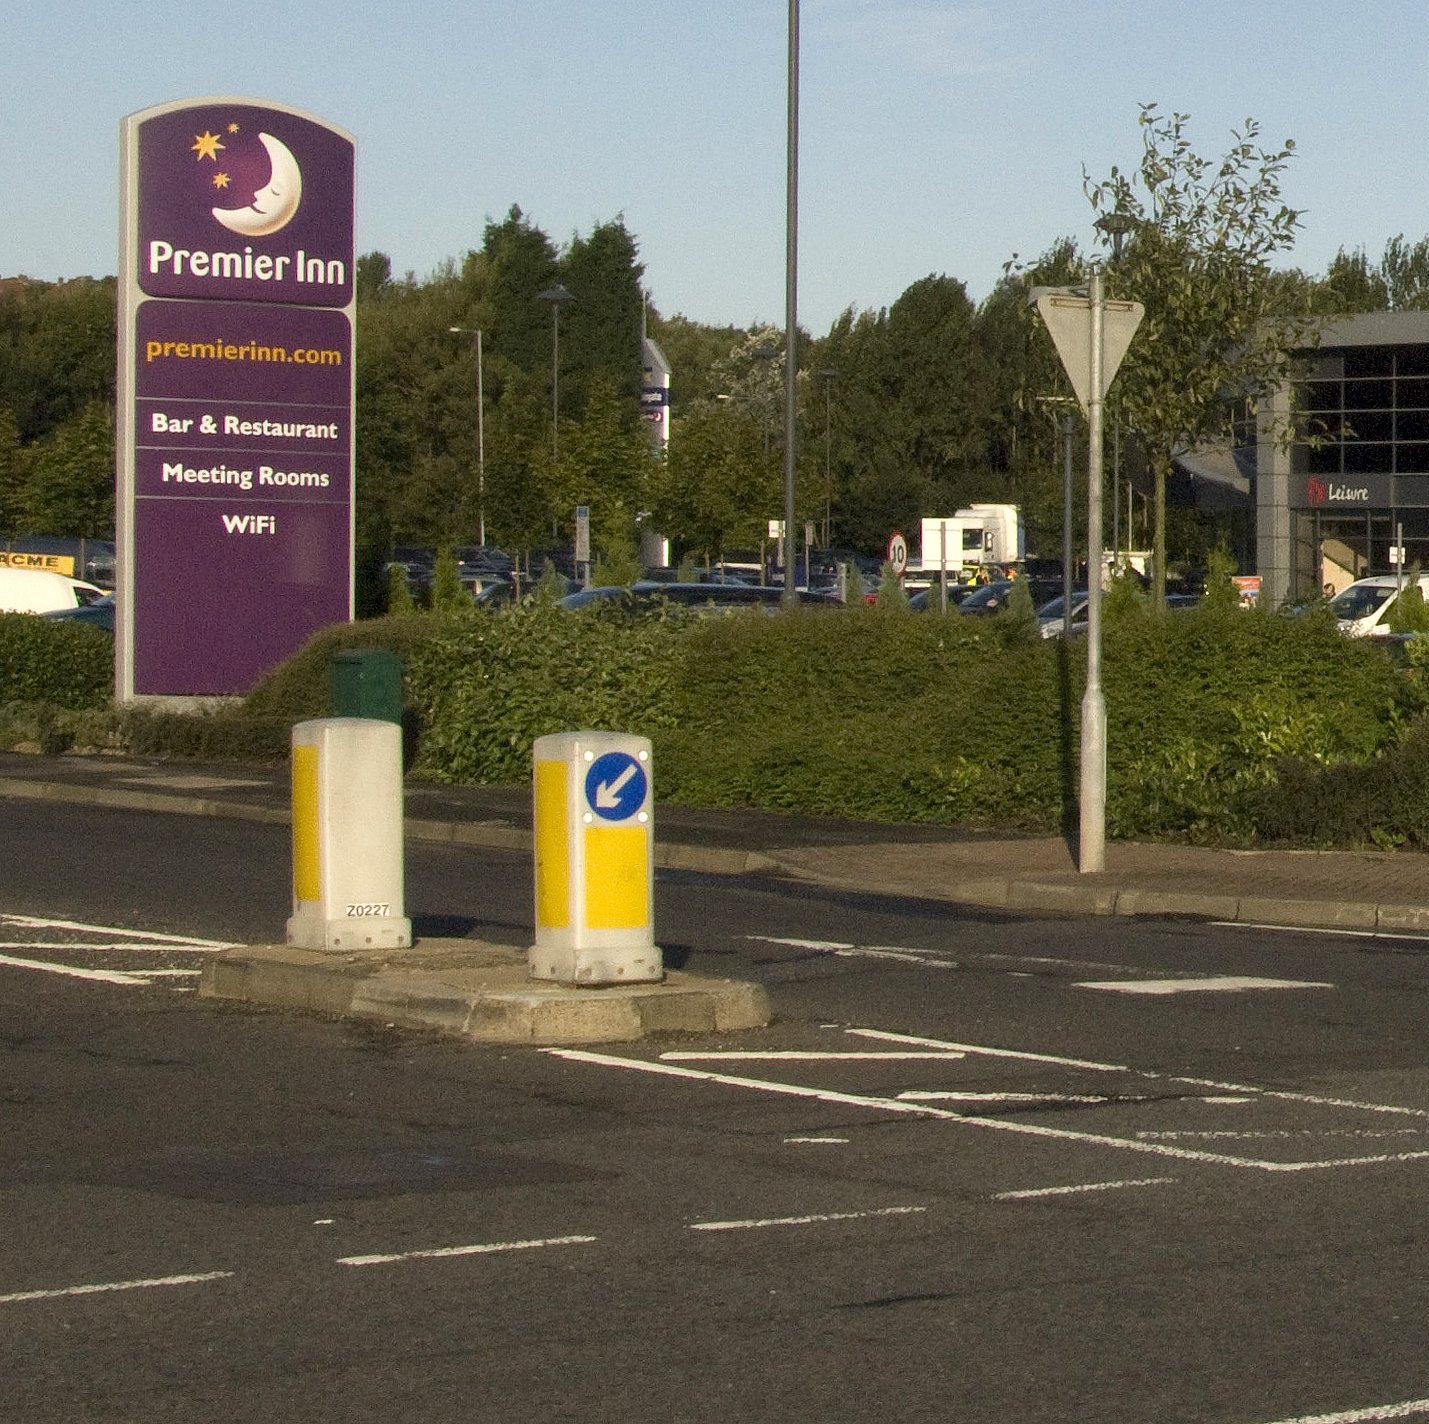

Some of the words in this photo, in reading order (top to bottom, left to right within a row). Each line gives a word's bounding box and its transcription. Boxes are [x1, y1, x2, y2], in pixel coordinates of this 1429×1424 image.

[149, 240, 291, 281] Premier
[297, 250, 345, 285] Inn
[146, 338, 342, 366] premierinn.com
[151, 412, 194, 433] Bar
[199, 414, 218, 435] &
[224, 415, 339, 440] Restaurant
[162, 463, 254, 491] Meeting
[258, 466, 330, 488] Rooms
[1328, 483, 1369, 501] Leisure
[222, 514, 277, 535] WiFi
[892, 544, 904, 564] 10
